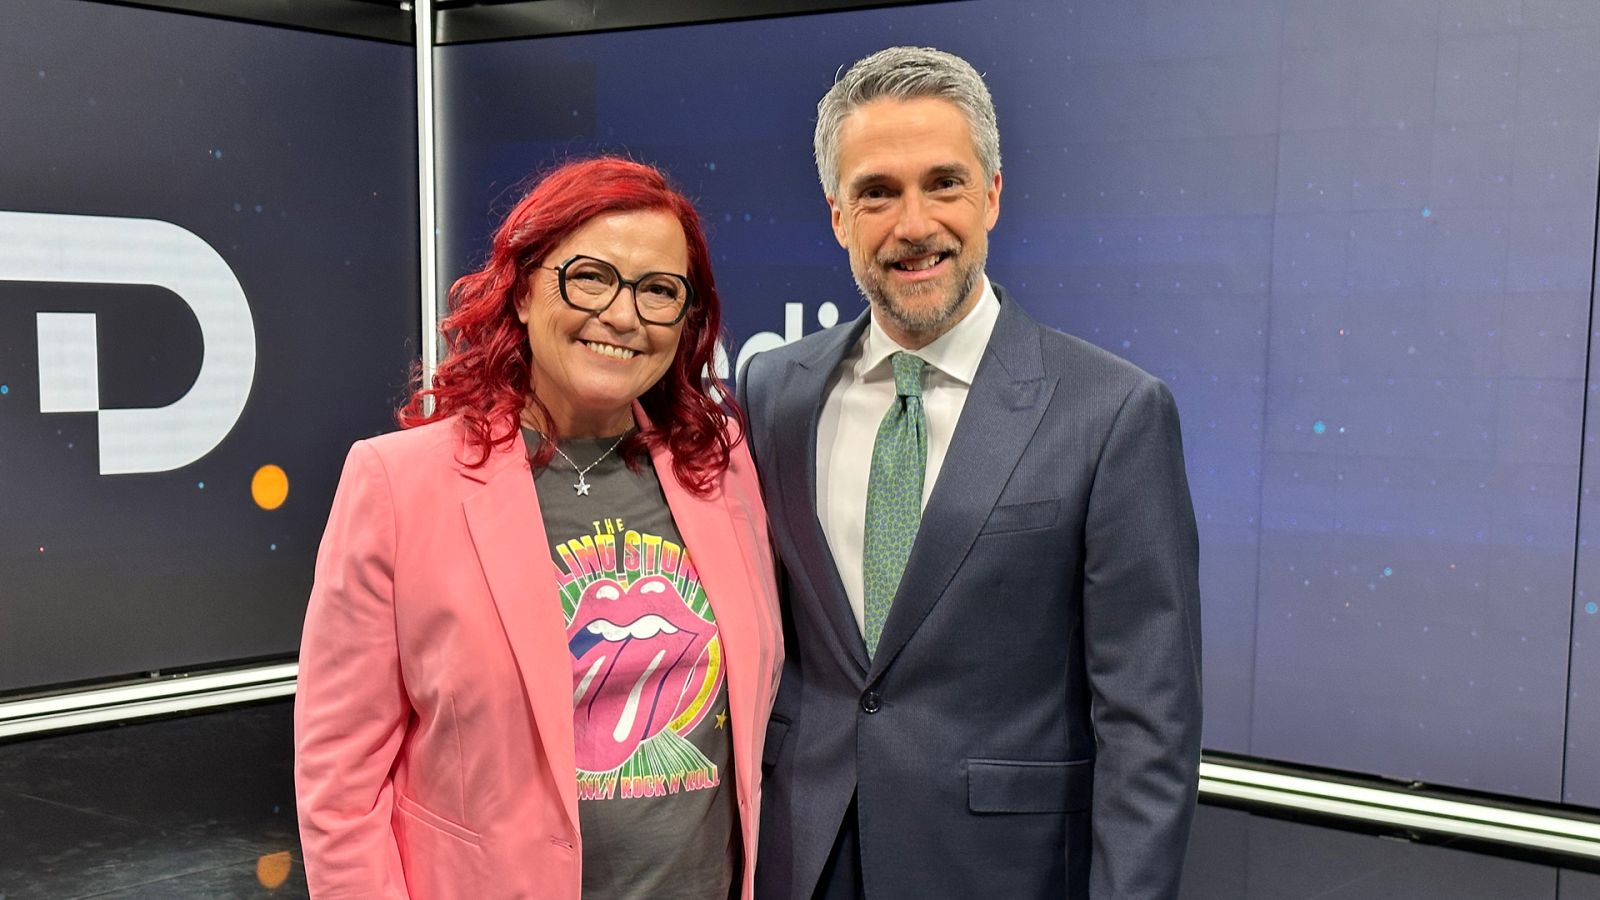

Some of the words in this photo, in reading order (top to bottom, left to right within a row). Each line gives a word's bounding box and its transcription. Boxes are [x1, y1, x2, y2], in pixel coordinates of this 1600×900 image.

[593, 518, 625, 535] THE
[621, 774, 666, 799] ROCK
[686, 766, 720, 792] ROLL
